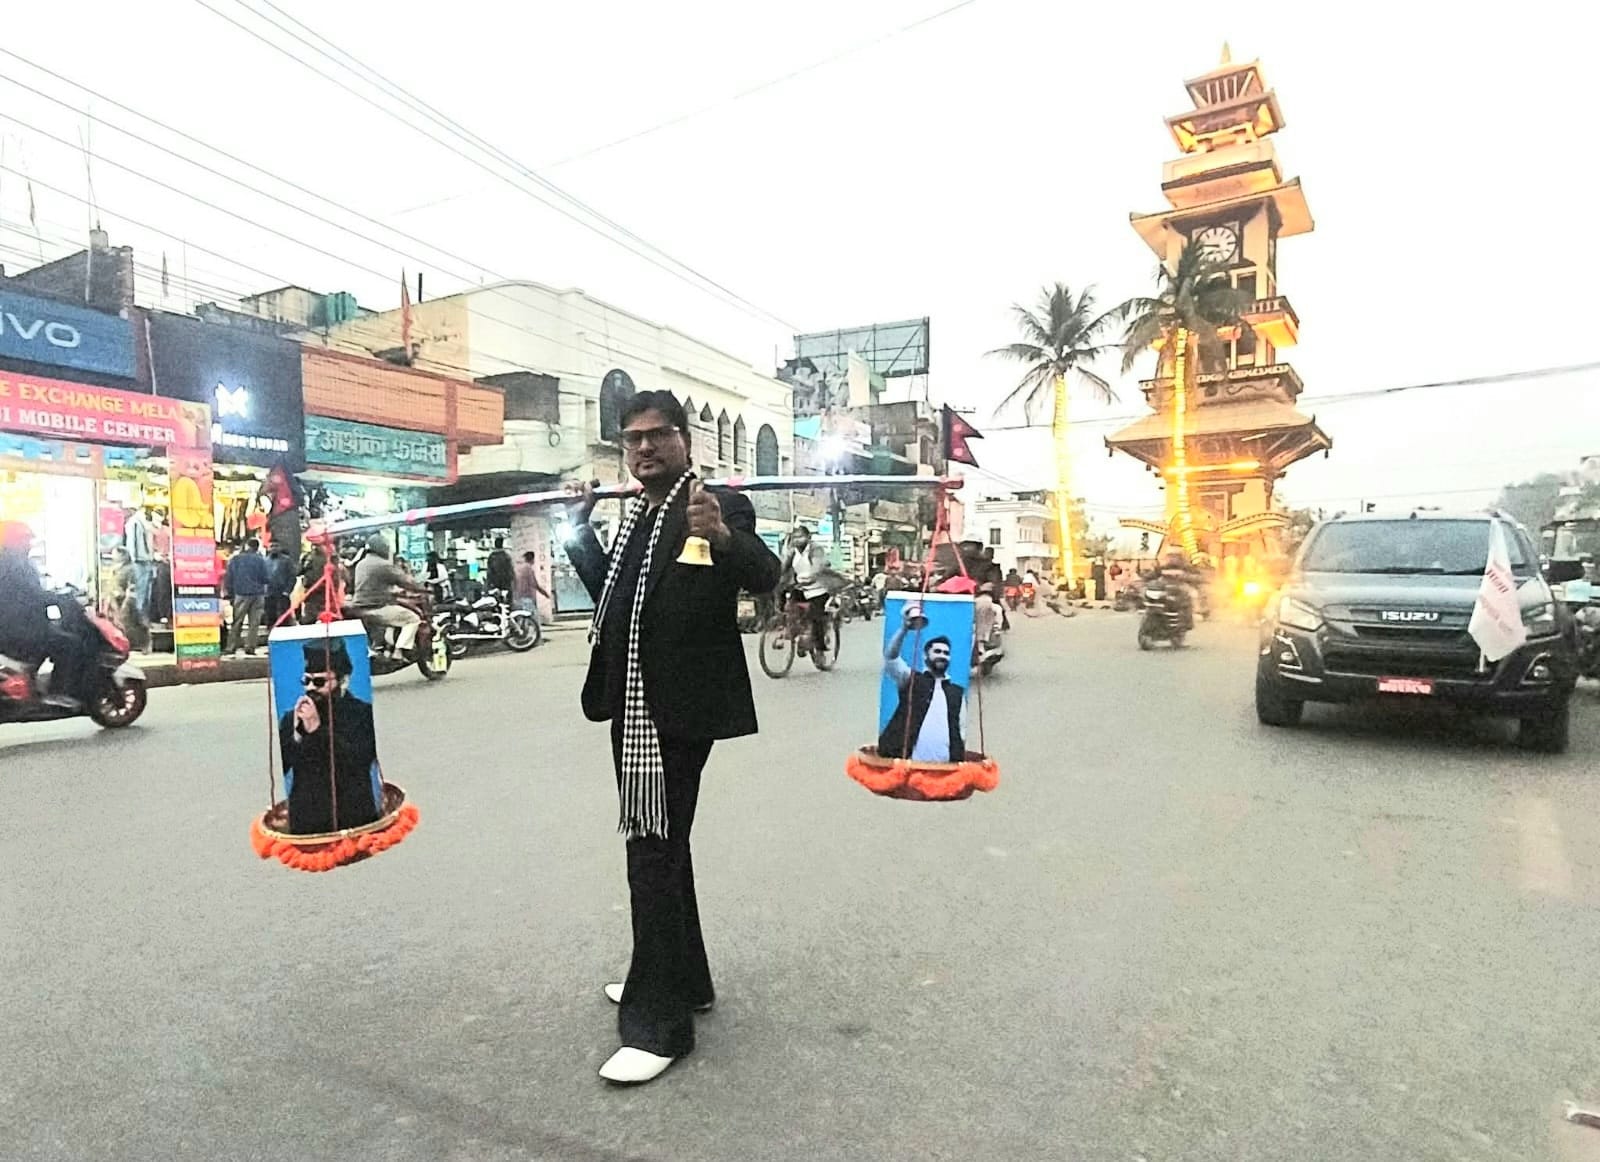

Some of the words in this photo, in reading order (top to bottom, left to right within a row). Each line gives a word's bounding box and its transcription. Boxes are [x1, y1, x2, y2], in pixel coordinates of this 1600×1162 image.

[19, 383, 124, 415] EXCHANGE
[130, 401, 177, 420] MELA
[19, 408, 97, 433] MOBILE
[103, 420, 175, 443] CENTER
[1382, 610, 1439, 621] ISUZU
